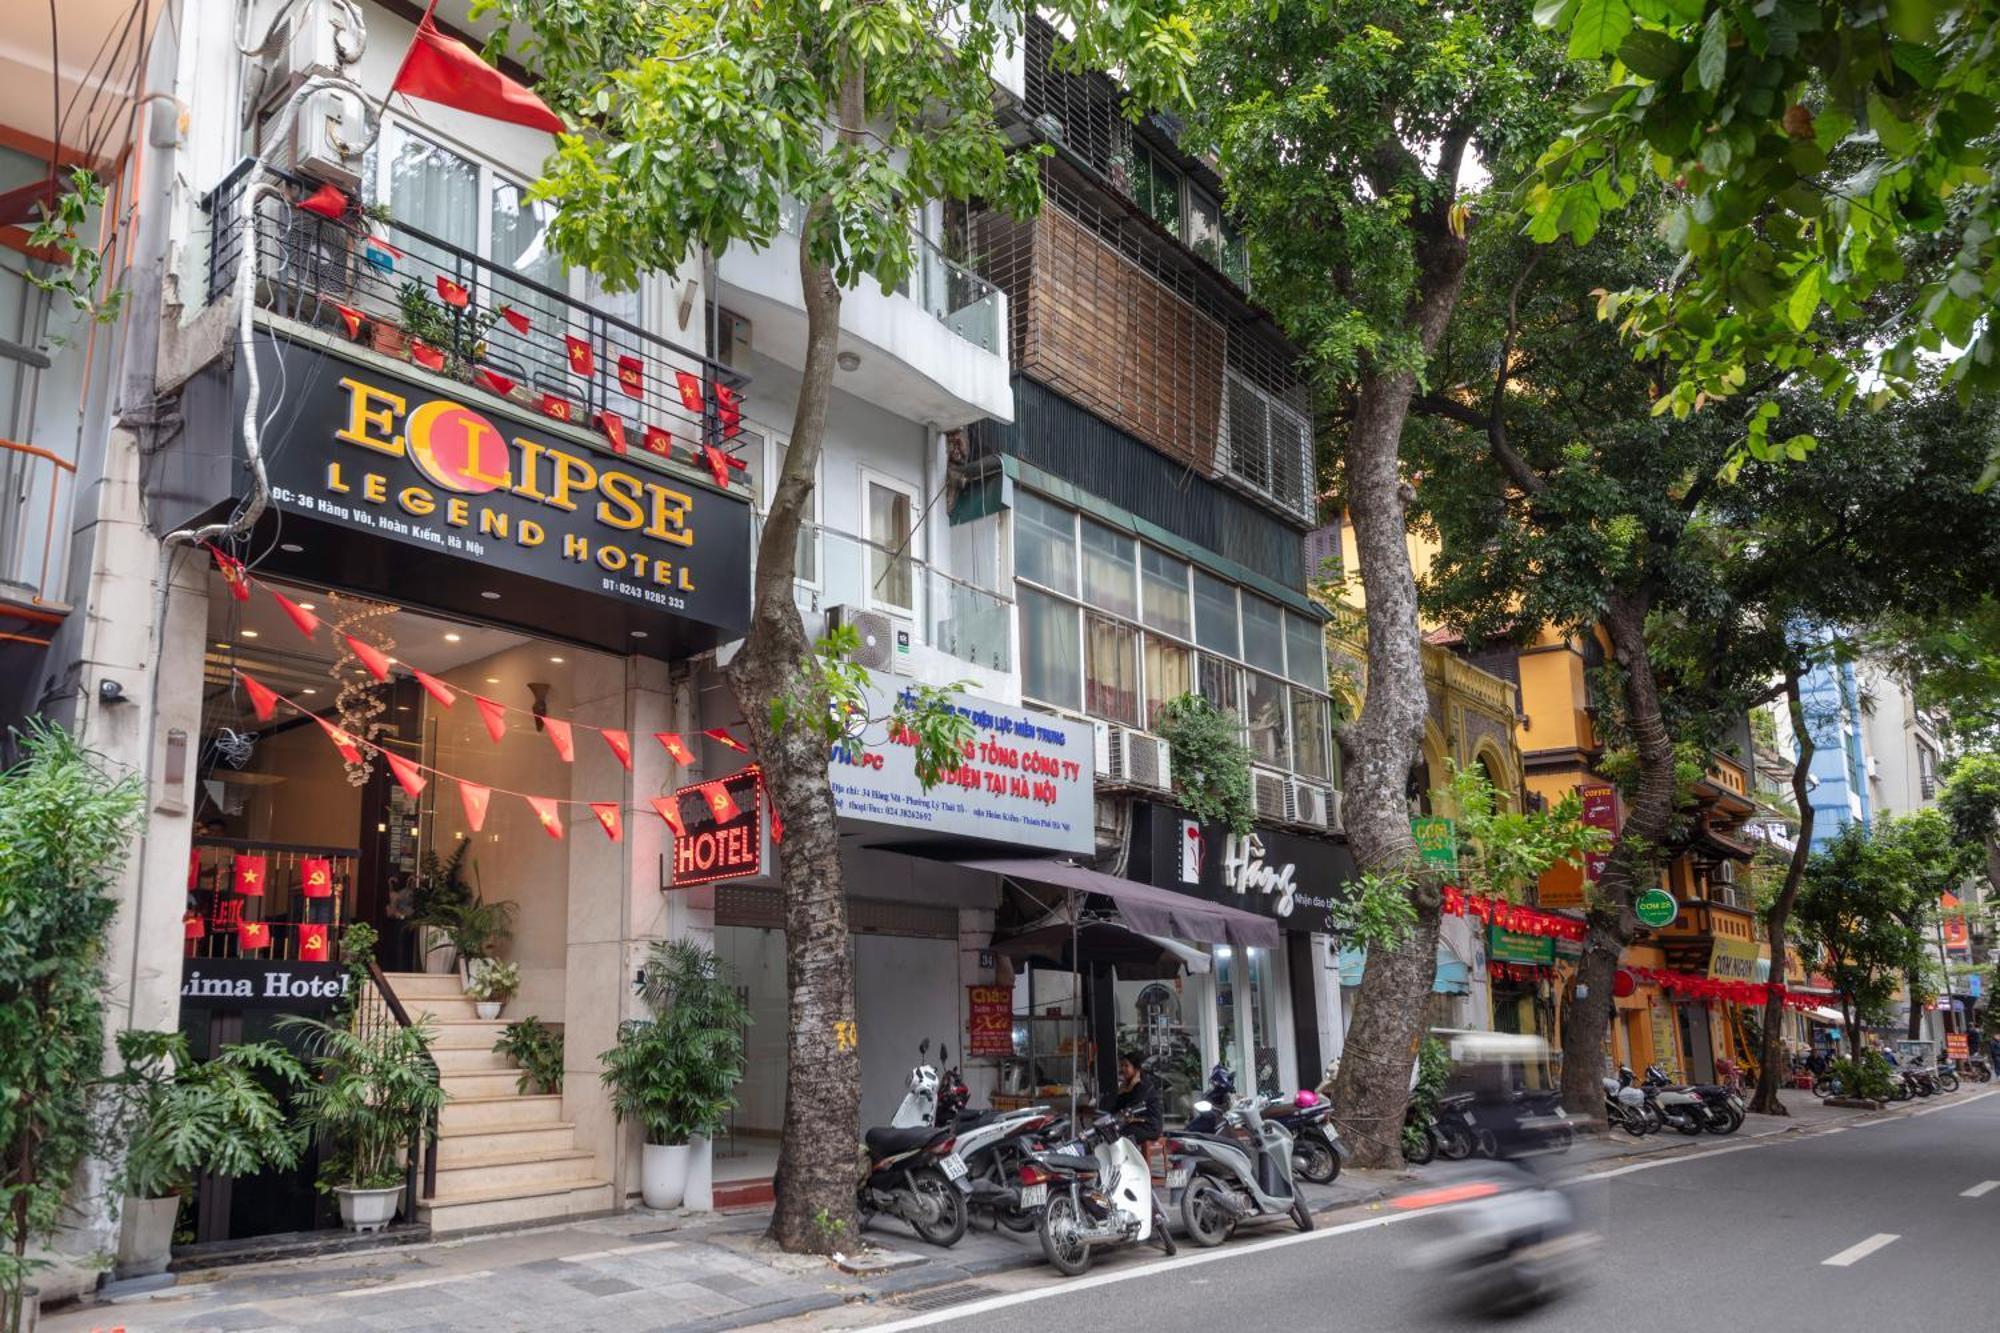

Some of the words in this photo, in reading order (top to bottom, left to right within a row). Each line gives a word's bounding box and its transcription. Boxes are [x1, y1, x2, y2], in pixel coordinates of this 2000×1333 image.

[298, 493, 314, 509] 36
[318, 499, 349, 519] Hàng
[379, 516, 409, 535] Hoàn
[447, 535, 462, 550] Hà
[328, 462, 546, 548] LEGEND
[562, 534, 696, 592] HOTEL
[667, 596, 686, 610] 333
[971, 710, 994, 732] ĐIỆN
[995, 715, 1013, 736] LỰC
[1014, 716, 1036, 740] MIỀN
[1036, 726, 1066, 746] TRUNG
[979, 734, 1019, 770] TỔNG
[1021, 750, 1060, 779] CÔNG
[1062, 760, 1081, 783] TY
[984, 771, 1007, 799] TẠI
[1010, 774, 1030, 800] HÀ
[1032, 779, 1057, 808] NỘI
[678, 825, 753, 873] HOTEL
[262, 972, 350, 997] Hotel
